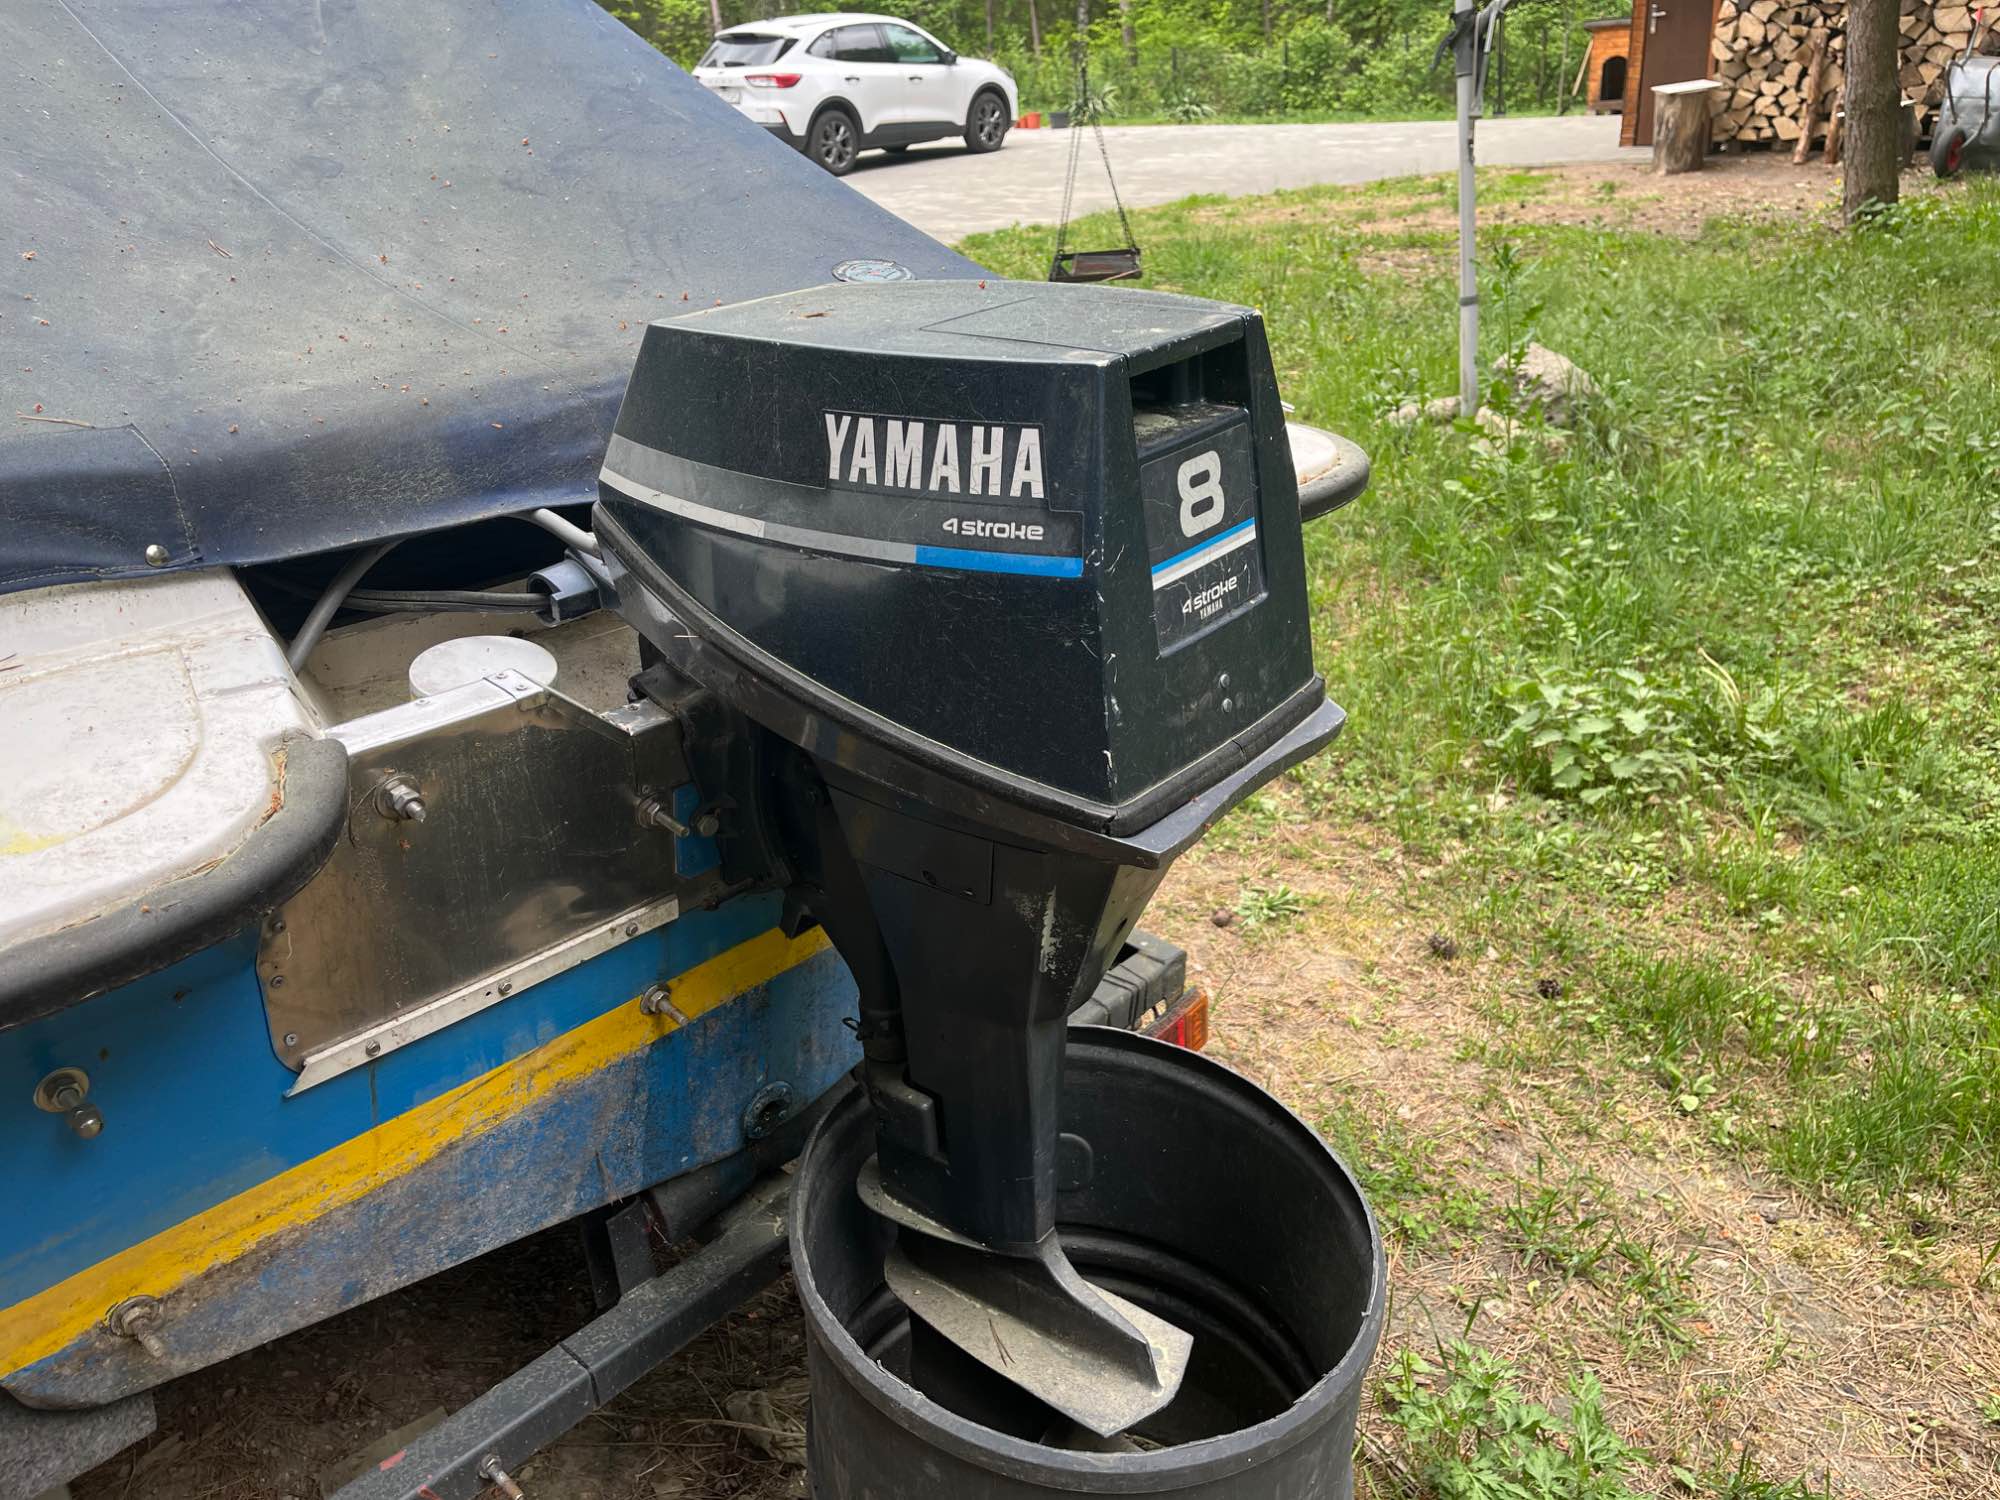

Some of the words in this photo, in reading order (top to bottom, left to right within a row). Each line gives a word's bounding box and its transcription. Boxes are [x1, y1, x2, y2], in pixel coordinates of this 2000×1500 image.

[824, 413, 1045, 499] YAMAHA
[1177, 450, 1226, 538] 8
[960, 519, 1045, 541] stroke
[1193, 575, 1238, 611] stroke
[1199, 598, 1223, 620] YAMAHA
